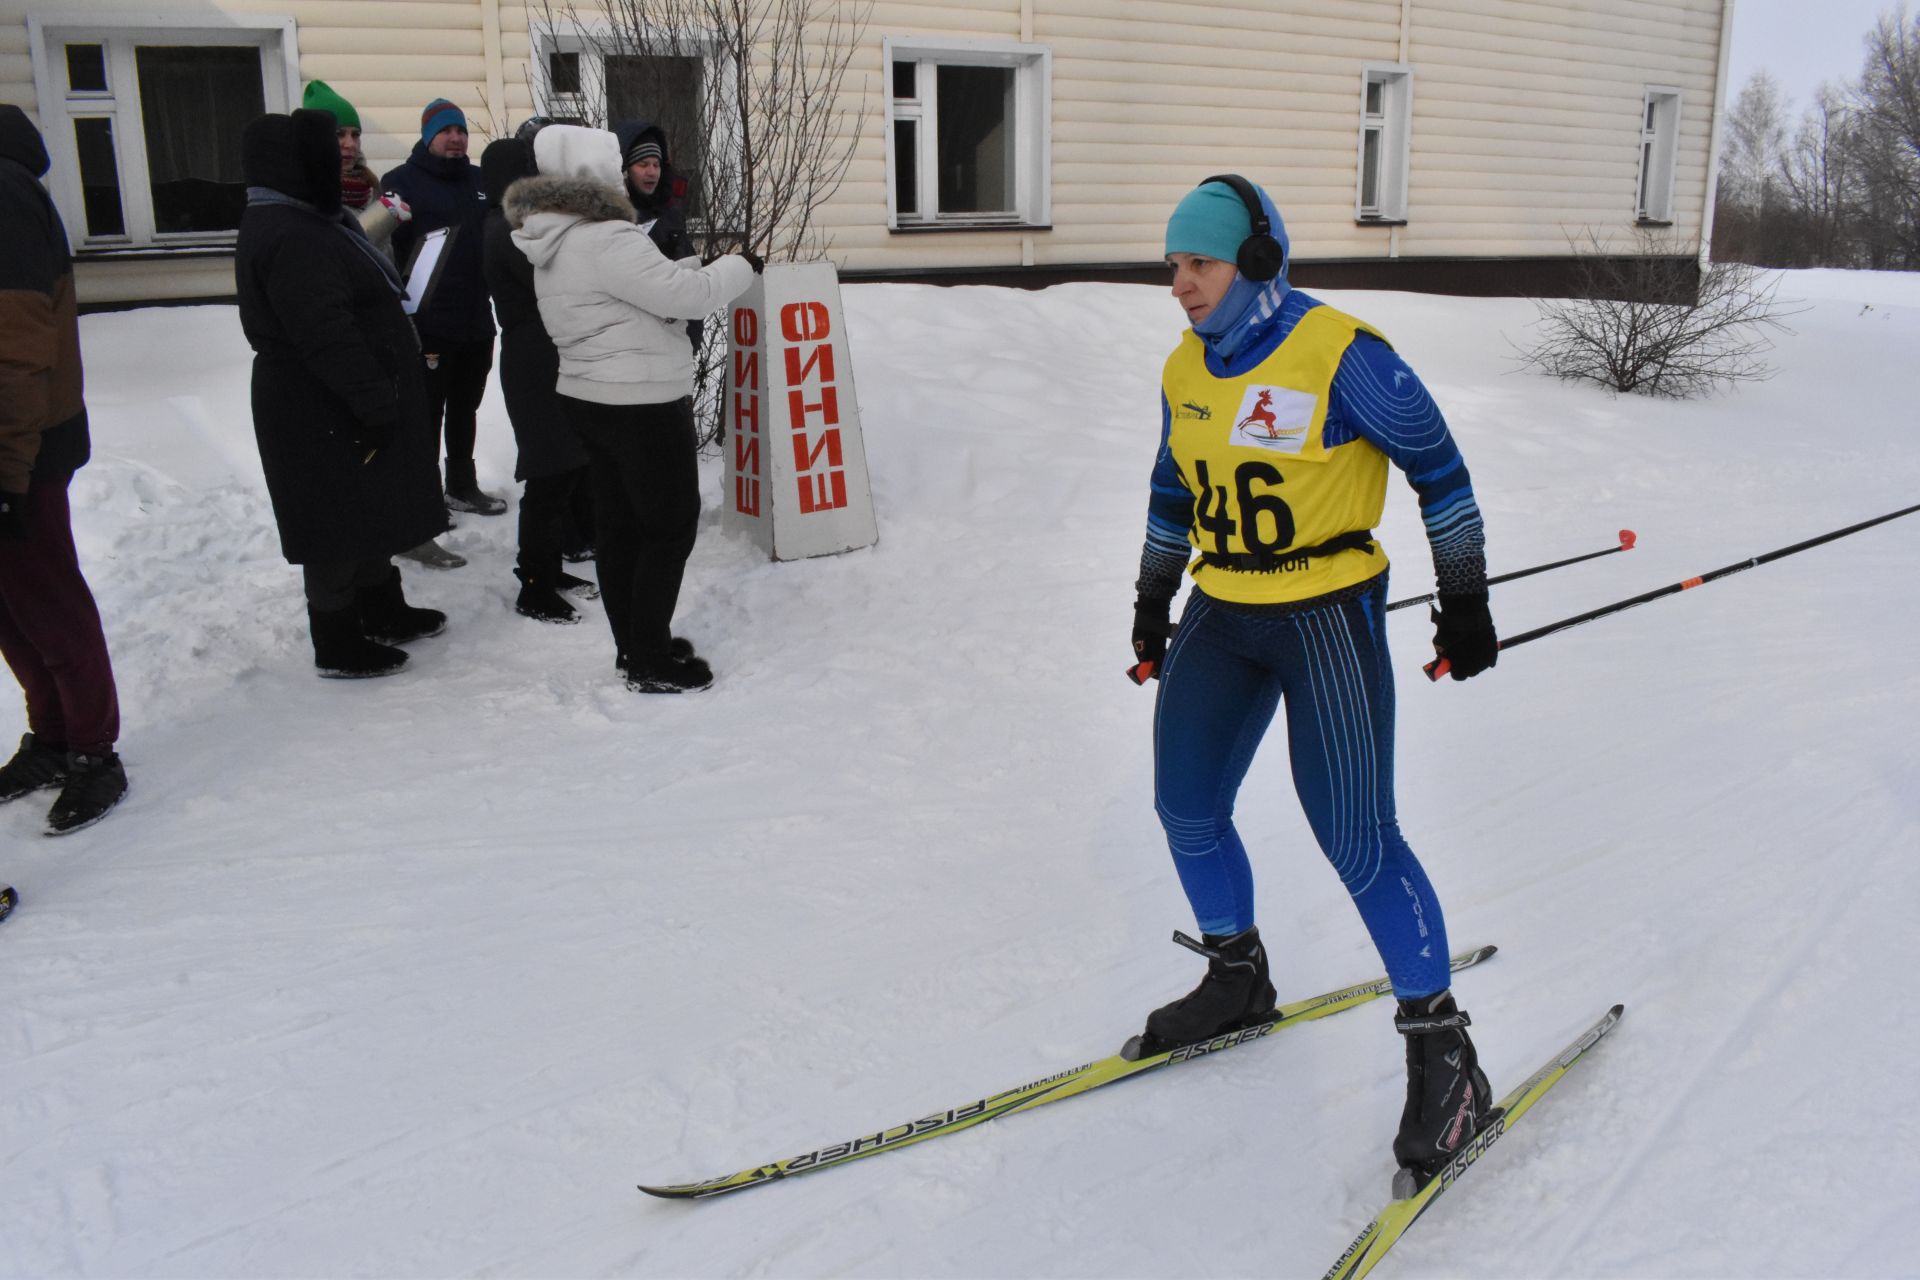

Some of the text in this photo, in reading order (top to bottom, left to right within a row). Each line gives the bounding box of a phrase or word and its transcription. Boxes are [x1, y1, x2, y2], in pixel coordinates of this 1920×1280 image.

[734, 307, 760, 518] ФИНИШ
[780, 301, 848, 515] ФИНИШ
[1166, 1022, 1274, 1066] FISCHER
[1397, 1017, 1460, 1031] SPINE
[785, 1098, 987, 1170] FISCHER
[1439, 1117, 1505, 1193] FISCHER
